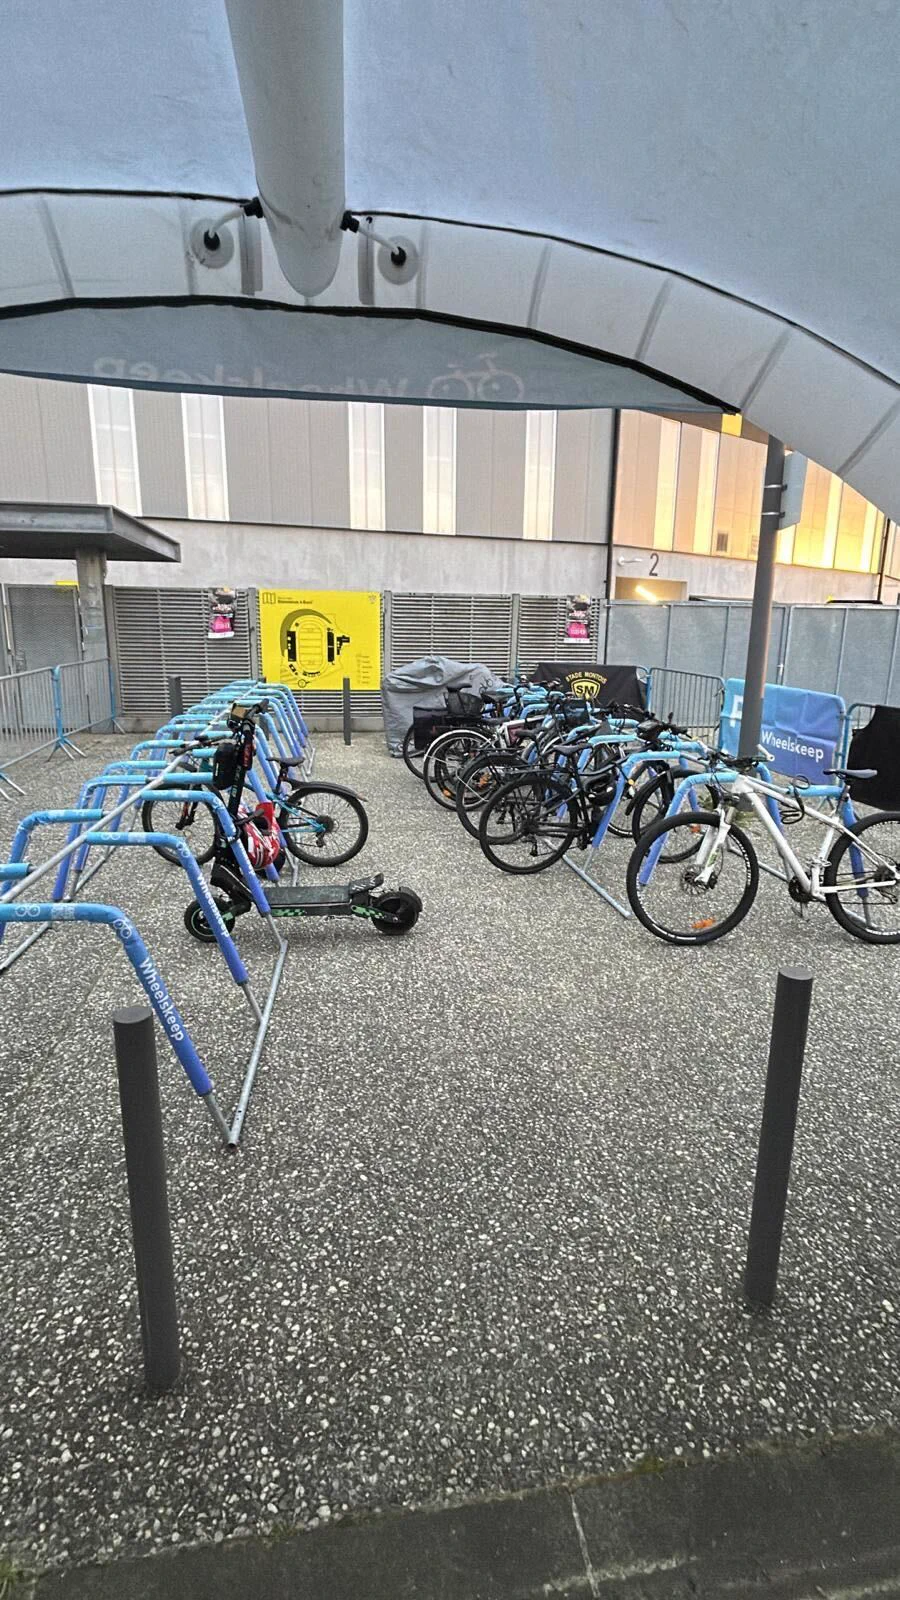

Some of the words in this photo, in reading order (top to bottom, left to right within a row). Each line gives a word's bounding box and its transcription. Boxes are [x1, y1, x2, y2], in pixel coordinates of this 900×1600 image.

[649, 553, 659, 576] 2
[565, 672, 582, 682] STADE
[584, 672, 607, 684] MONTOIS
[576, 685, 595, 696] SM
[761, 730, 824, 763] Wheelskeep
[138, 957, 185, 1042] Wheelskeep
